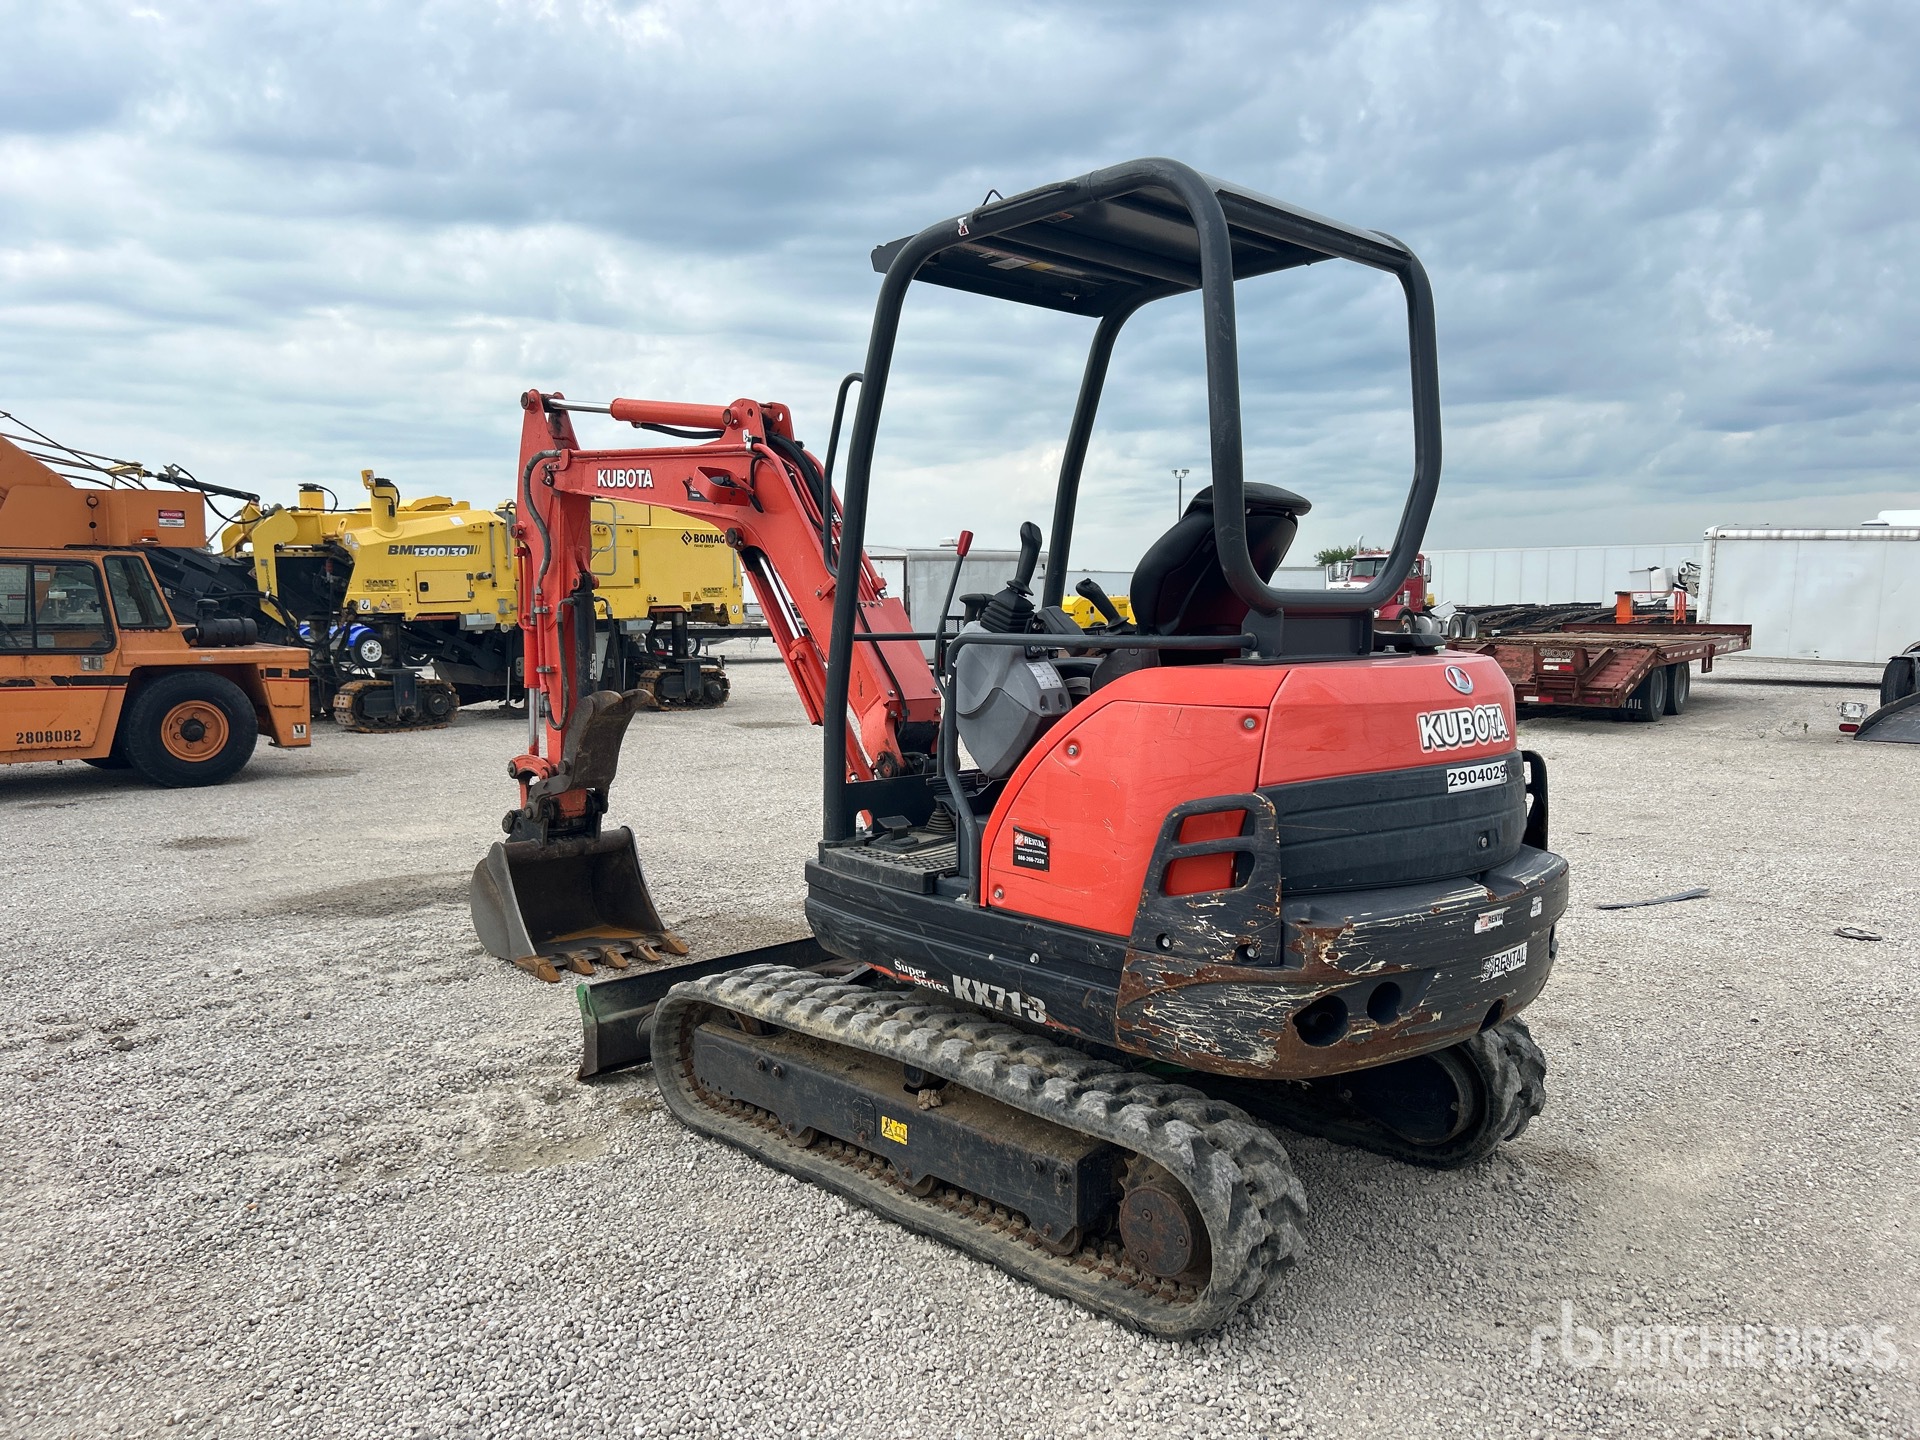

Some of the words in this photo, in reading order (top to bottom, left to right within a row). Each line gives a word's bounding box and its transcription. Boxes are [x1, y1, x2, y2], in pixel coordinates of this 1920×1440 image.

[597, 468, 654, 489] KUBOTA
[694, 533, 725, 544] BOMAG
[16, 729, 82, 745] 2808082
[1418, 704, 1509, 750] KUBOTA
[1447, 763, 1507, 788] 2904029
[894, 958, 927, 979] Super
[1494, 947, 1525, 973] RENTAL
[913, 975, 950, 993] Series
[952, 974, 1048, 1024] KX71-3
